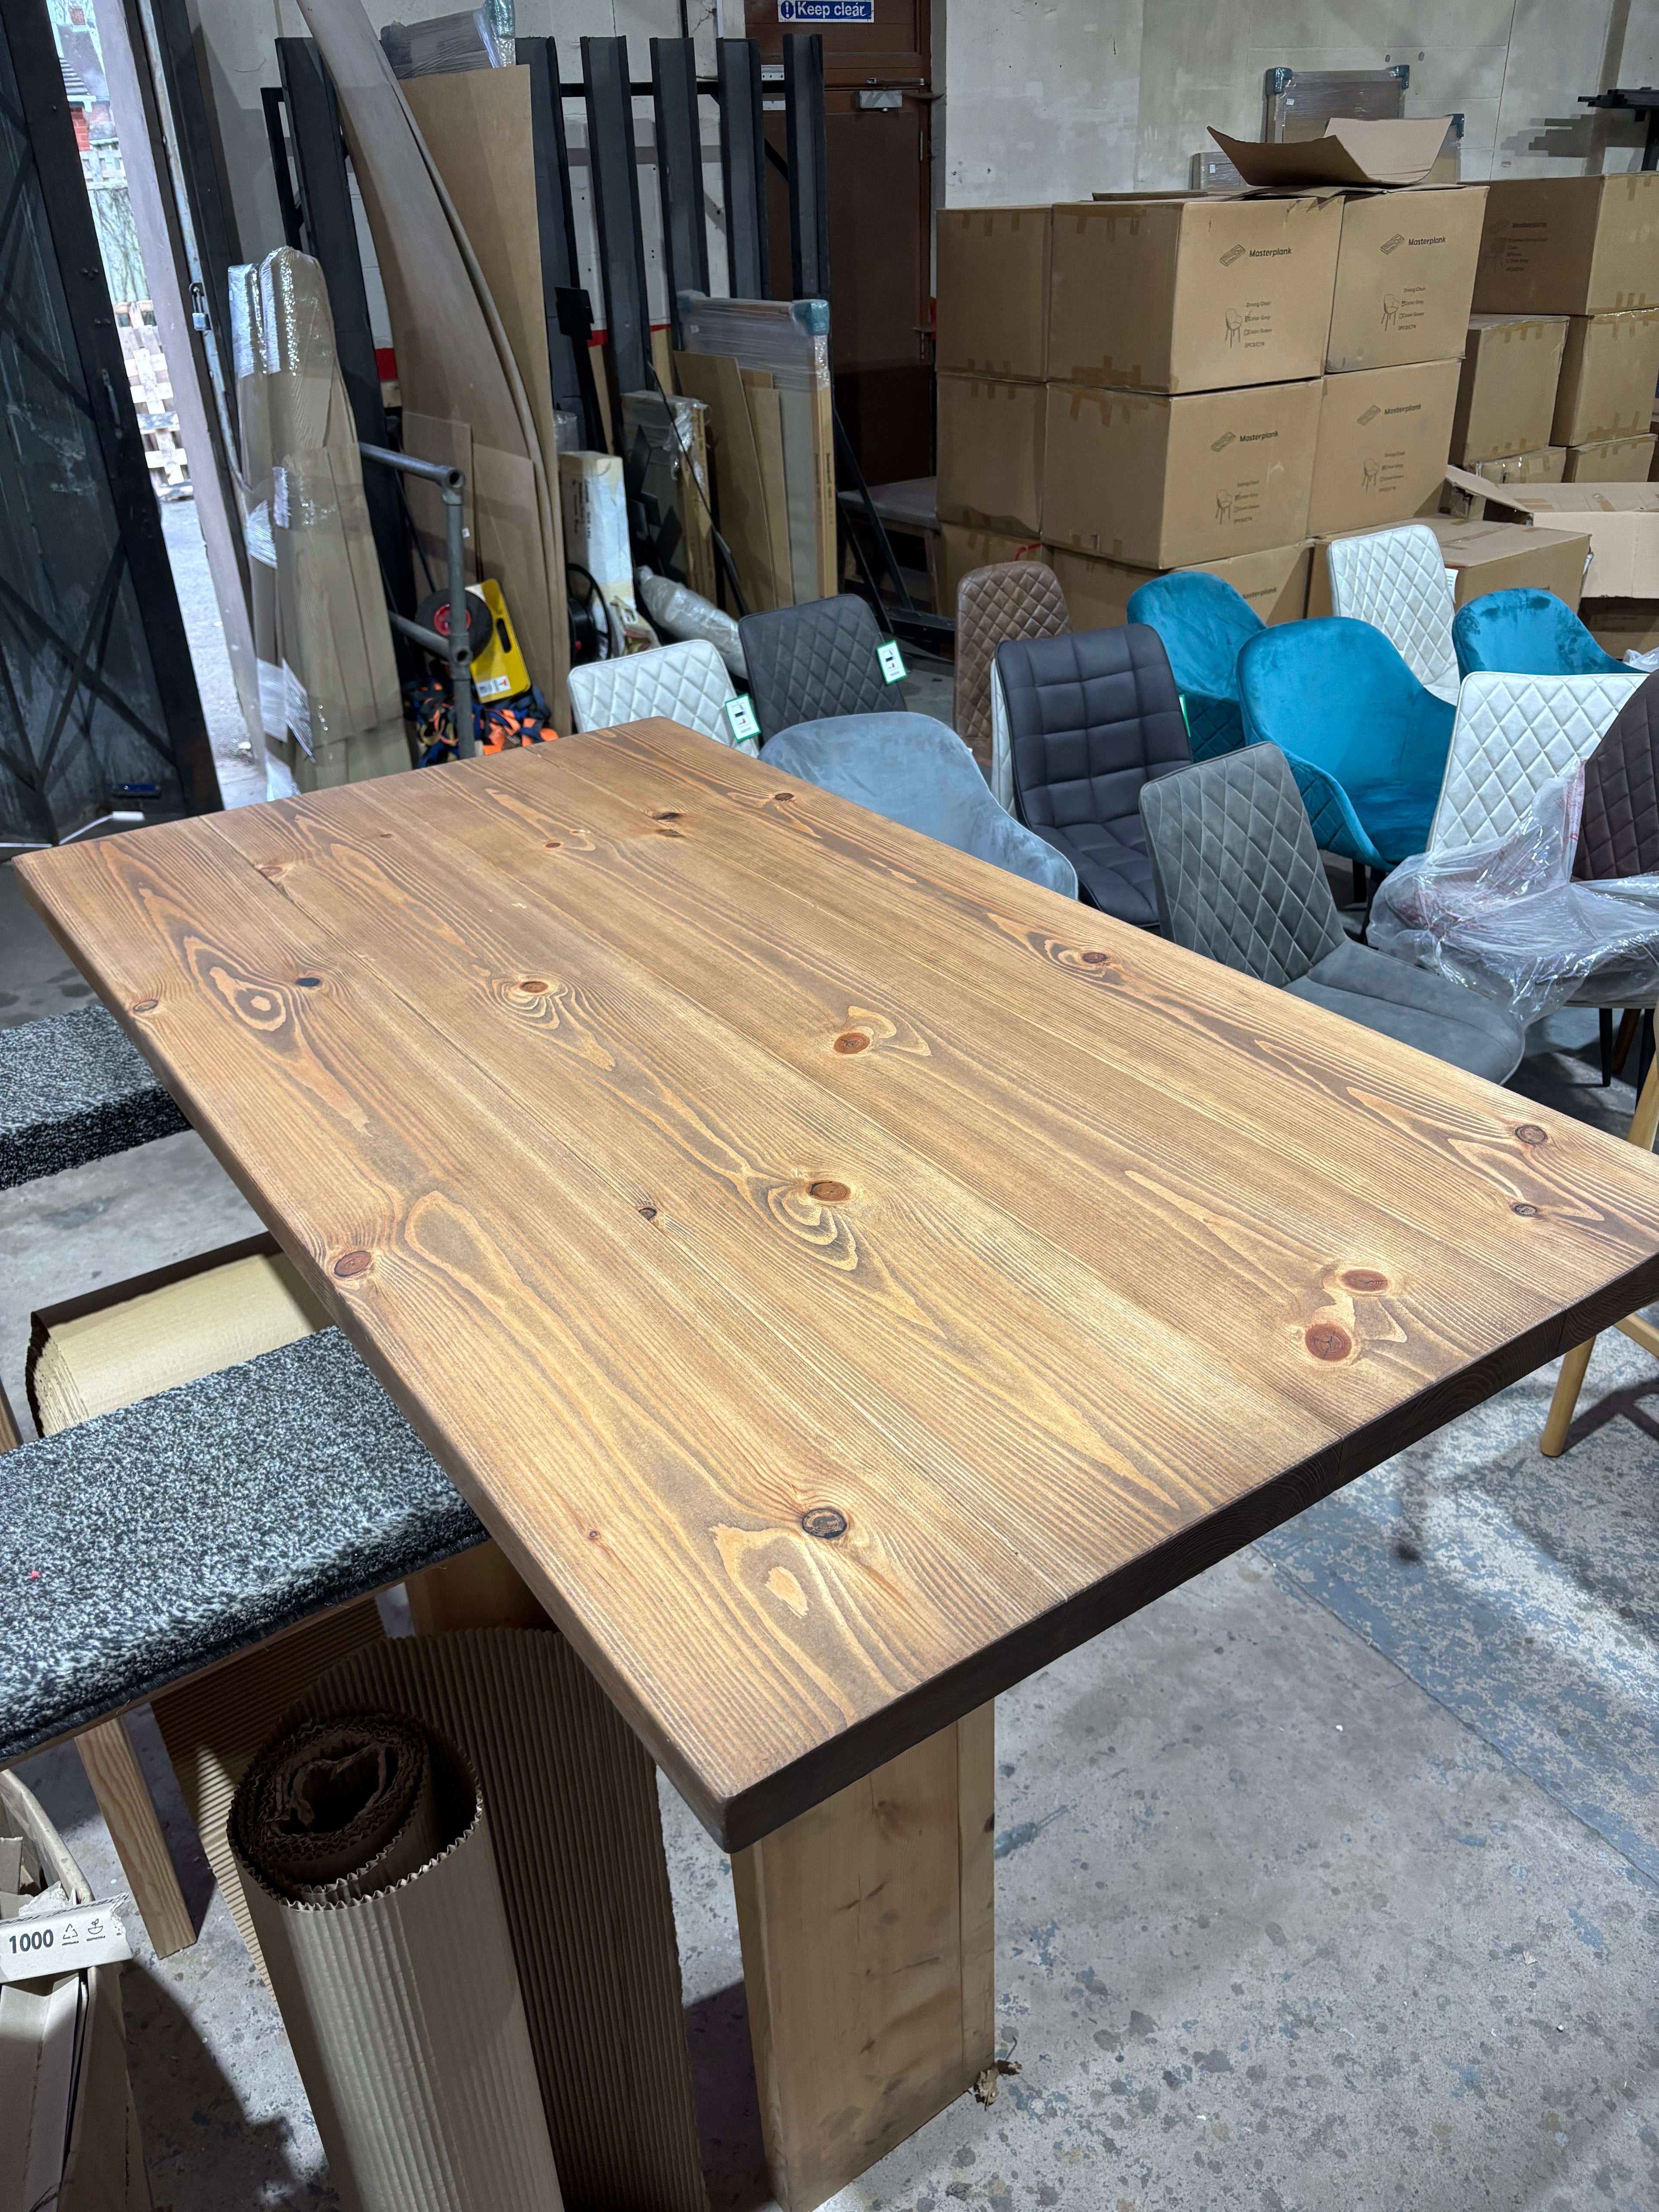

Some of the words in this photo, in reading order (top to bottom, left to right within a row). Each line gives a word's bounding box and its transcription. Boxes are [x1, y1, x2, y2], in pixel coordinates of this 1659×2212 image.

[798, 1, 830, 19] Keep
[834, 2, 865, 16] clear
[1408, 236, 1446, 246] Masterplank
[1249, 247, 1292, 257] Masterplank
[1384, 404, 1421, 415] Masterplank
[1240, 430, 1278, 442] Masterplank
[9, 1929, 54, 1954] 1000
